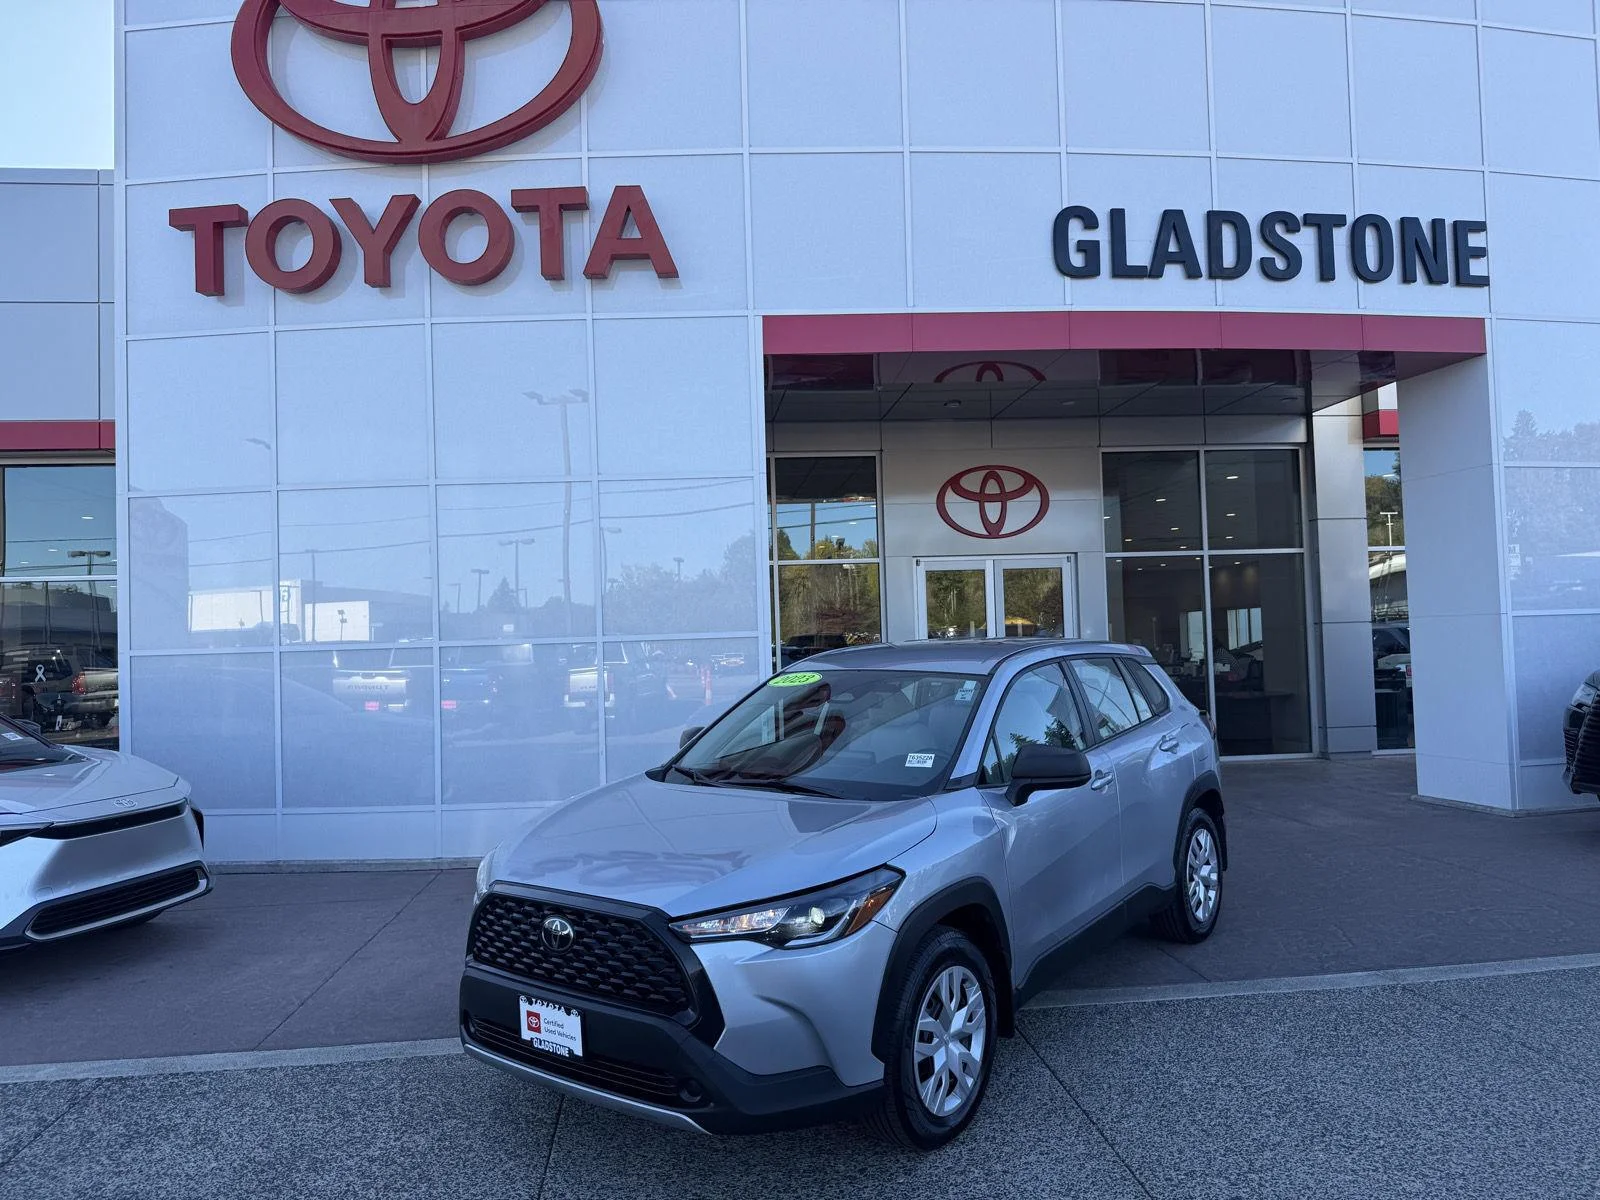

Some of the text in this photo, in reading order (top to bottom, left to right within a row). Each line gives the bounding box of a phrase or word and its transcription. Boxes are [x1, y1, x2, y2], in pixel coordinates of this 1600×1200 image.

[169, 185, 679, 297] TOYOTA
[1052, 205, 1491, 287] GLADSTONE
[773, 674, 816, 685] 2023
[531, 998, 566, 1013] TOYOTA
[543, 1018, 565, 1029] Certified
[544, 1027, 577, 1041] Used Vehicles
[532, 1037, 570, 1057] GLADSTONE
